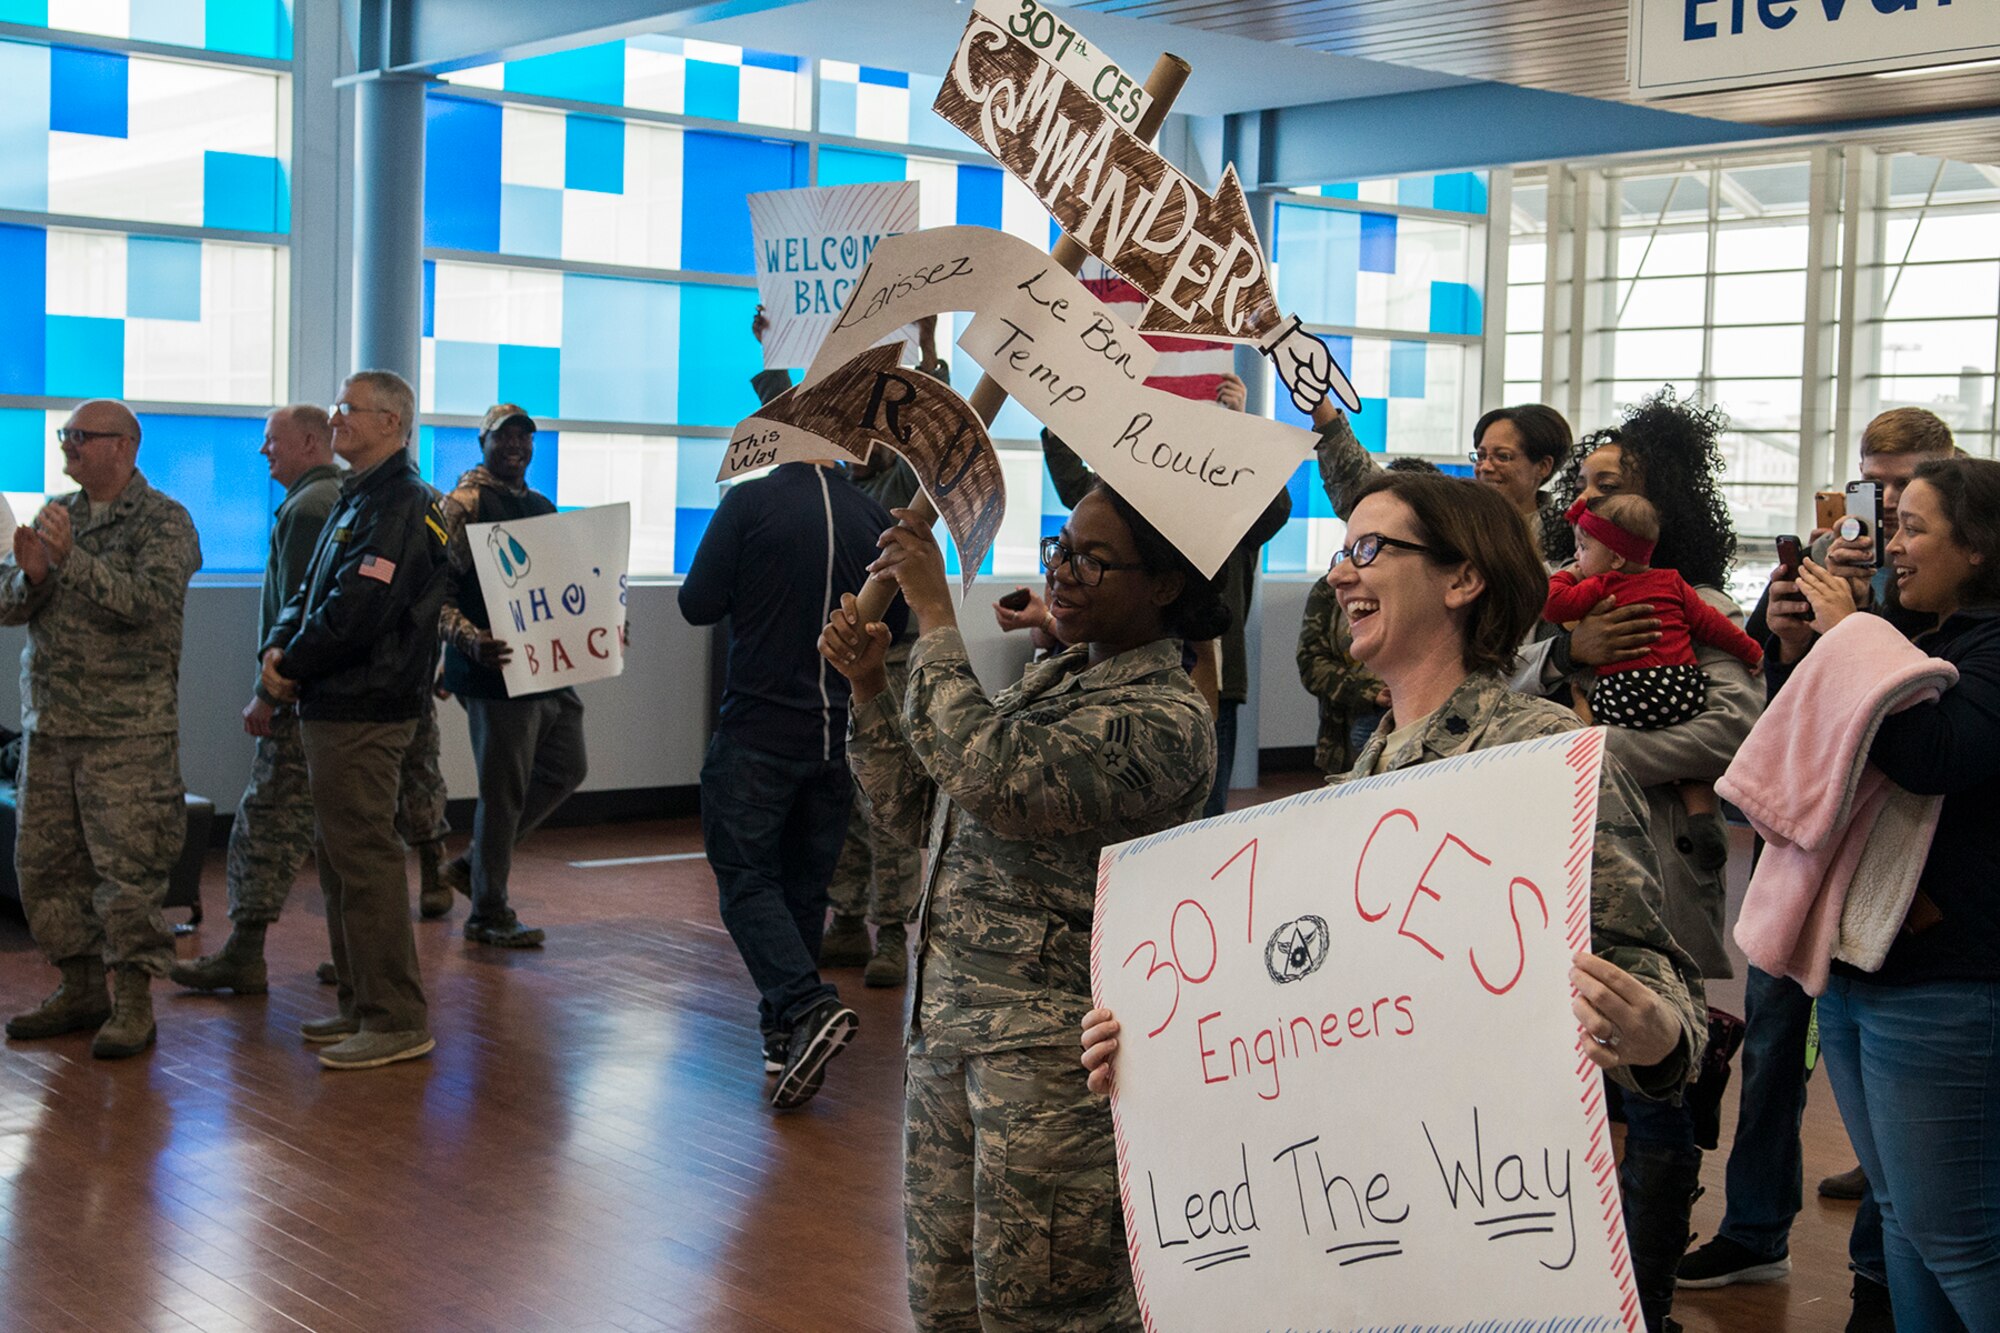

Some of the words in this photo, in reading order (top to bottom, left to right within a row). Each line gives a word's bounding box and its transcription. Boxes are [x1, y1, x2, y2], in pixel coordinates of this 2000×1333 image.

[1092, 65, 1143, 124] CES
[955, 19, 1260, 335] COMMANDER
[764, 232, 904, 274] WELCOM
[795, 278, 857, 315] BAC
[832, 256, 973, 333] Laissez
[1017, 268, 1070, 323] Le
[1080, 311, 1135, 379] Bon
[730, 429, 780, 454] This
[994, 317, 1086, 406] Temp
[1113, 412, 1255, 487] Rouler
[731, 448, 777, 471] Way
[1122, 838, 1258, 1038] 307
[1355, 808, 1549, 995] CES
[1197, 994, 1415, 1100] Engineers
[1148, 1142, 1260, 1249] Lead
[1273, 1136, 1409, 1236] The
[1422, 1106, 1577, 1270] Way
